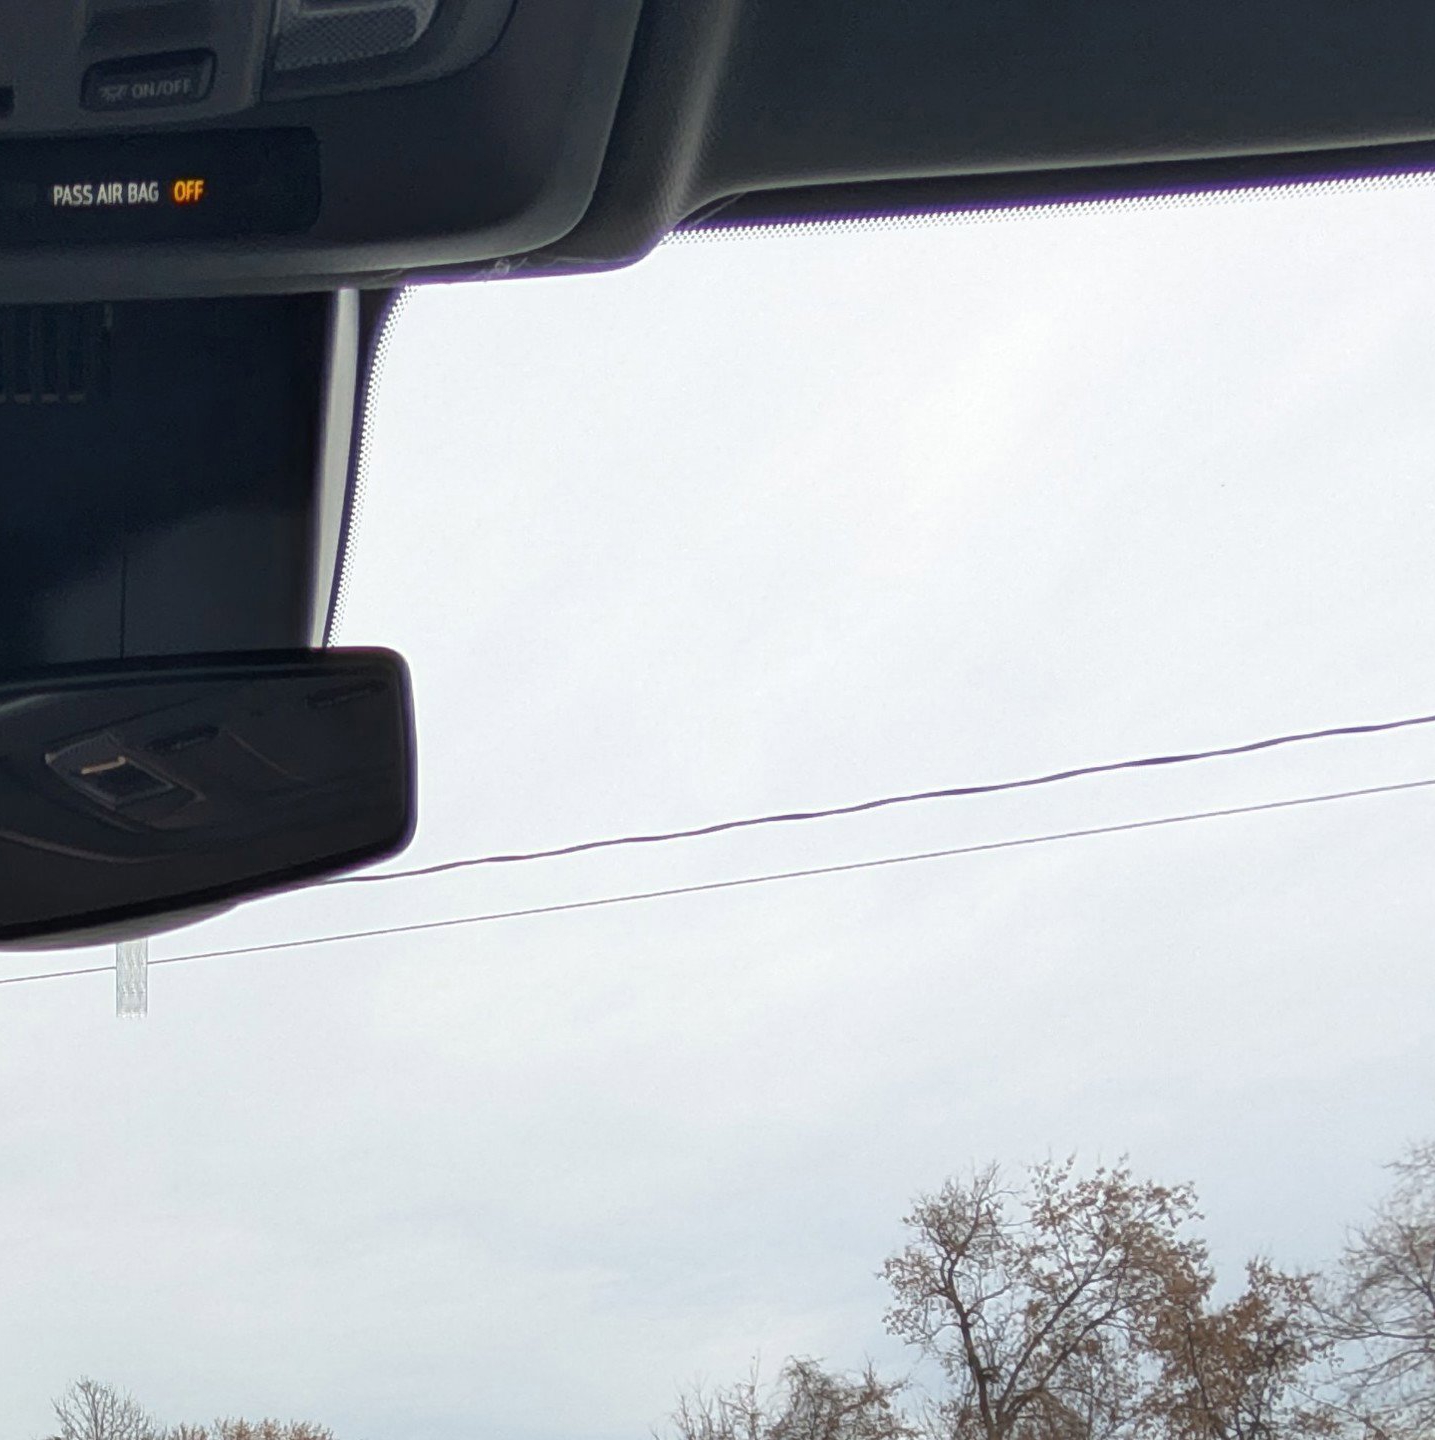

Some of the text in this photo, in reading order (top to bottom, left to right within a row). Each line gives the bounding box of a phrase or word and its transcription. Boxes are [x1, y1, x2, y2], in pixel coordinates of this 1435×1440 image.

[132, 78, 193, 99] ON/OFF
[53, 179, 204, 206] PASS AIR BAG OFF
